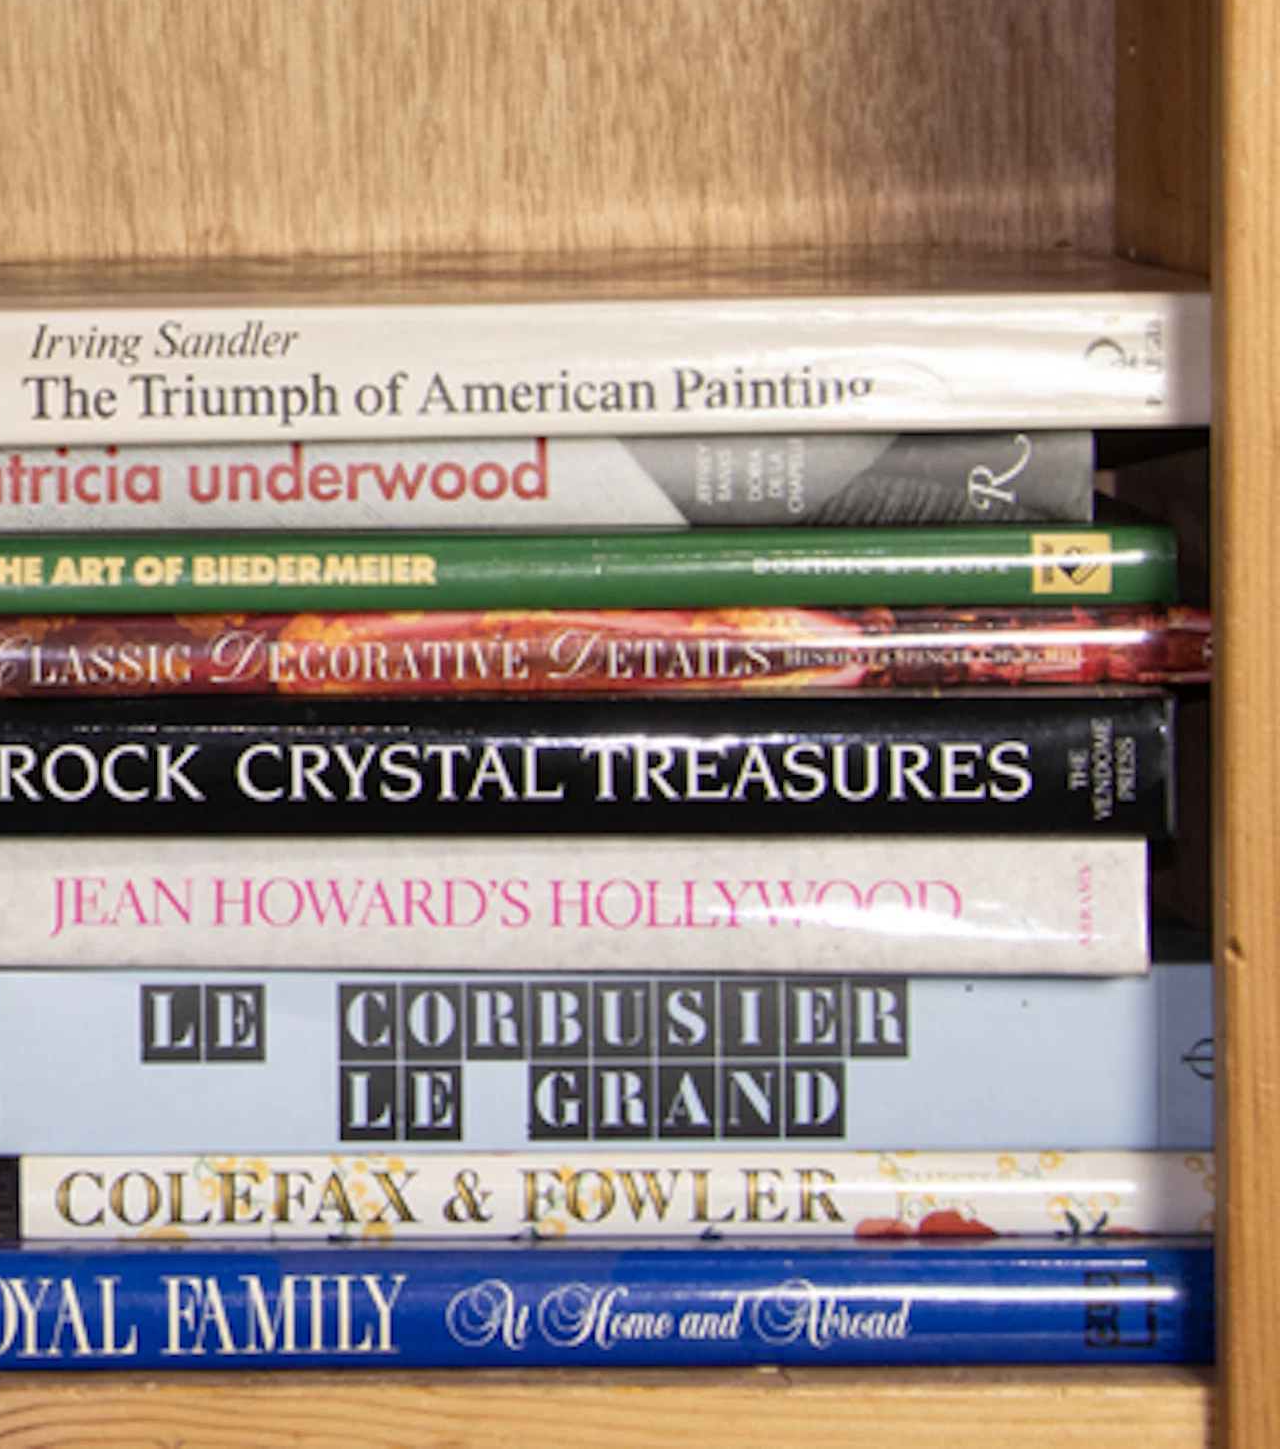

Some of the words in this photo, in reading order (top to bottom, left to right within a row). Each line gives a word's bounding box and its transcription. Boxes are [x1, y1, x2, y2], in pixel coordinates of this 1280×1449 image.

[29, 324, 141, 366] Irving
[154, 320, 300, 359] Sandler
[23, 375, 118, 420] The
[128, 374, 339, 426] Triumph
[355, 372, 407, 416] of
[419, 368, 657, 416] American
[672, 365, 875, 414] Painting
[187, 438, 550, 505] underwood
[50, 556, 132, 586] ART
[139, 556, 185, 585] OF
[192, 554, 437, 586] BIEDERMEIER
[209, 629, 531, 684] DECORATIVE
[546, 628, 771, 681] DETAILS
[234, 742, 566, 804] CRYSTAL
[580, 741, 1033, 802] TREASURES
[49, 877, 194, 937] JEAN
[213, 877, 532, 929] HOWARD'S
[549, 878, 964, 930] HOLLYWOOD
[145, 987, 263, 1057] LE
[342, 984, 908, 1056] CORBUSIER
[343, 1066, 460, 1136] LE
[530, 1066, 844, 1134] GRAND
[55, 1169, 421, 1228] COLEFAX
[443, 1170, 494, 1226] &
[521, 1167, 846, 1225] FOWLER
[161, 1273, 407, 1356] FAMILY
[446, 1278, 532, 1350] At
[540, 1279, 672, 1350] Home
[680, 1296, 744, 1341] and
[751, 1278, 911, 1350] Abroad
